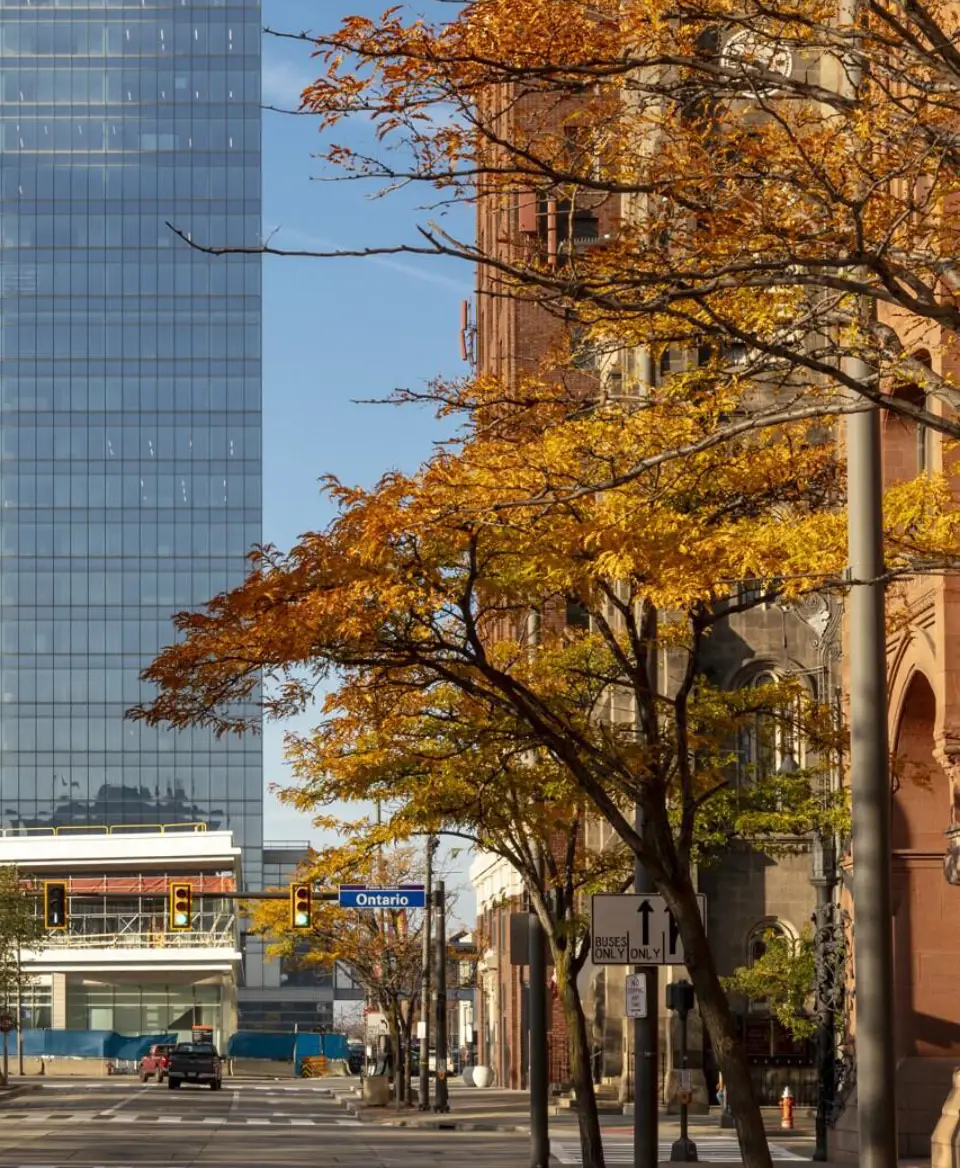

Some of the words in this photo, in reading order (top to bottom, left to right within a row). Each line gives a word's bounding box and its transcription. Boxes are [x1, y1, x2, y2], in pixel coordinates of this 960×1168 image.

[356, 893, 409, 905] Ontario
[595, 936, 627, 947] BUSES
[595, 948, 625, 959] ONLY
[630, 948, 661, 959] ONLY
